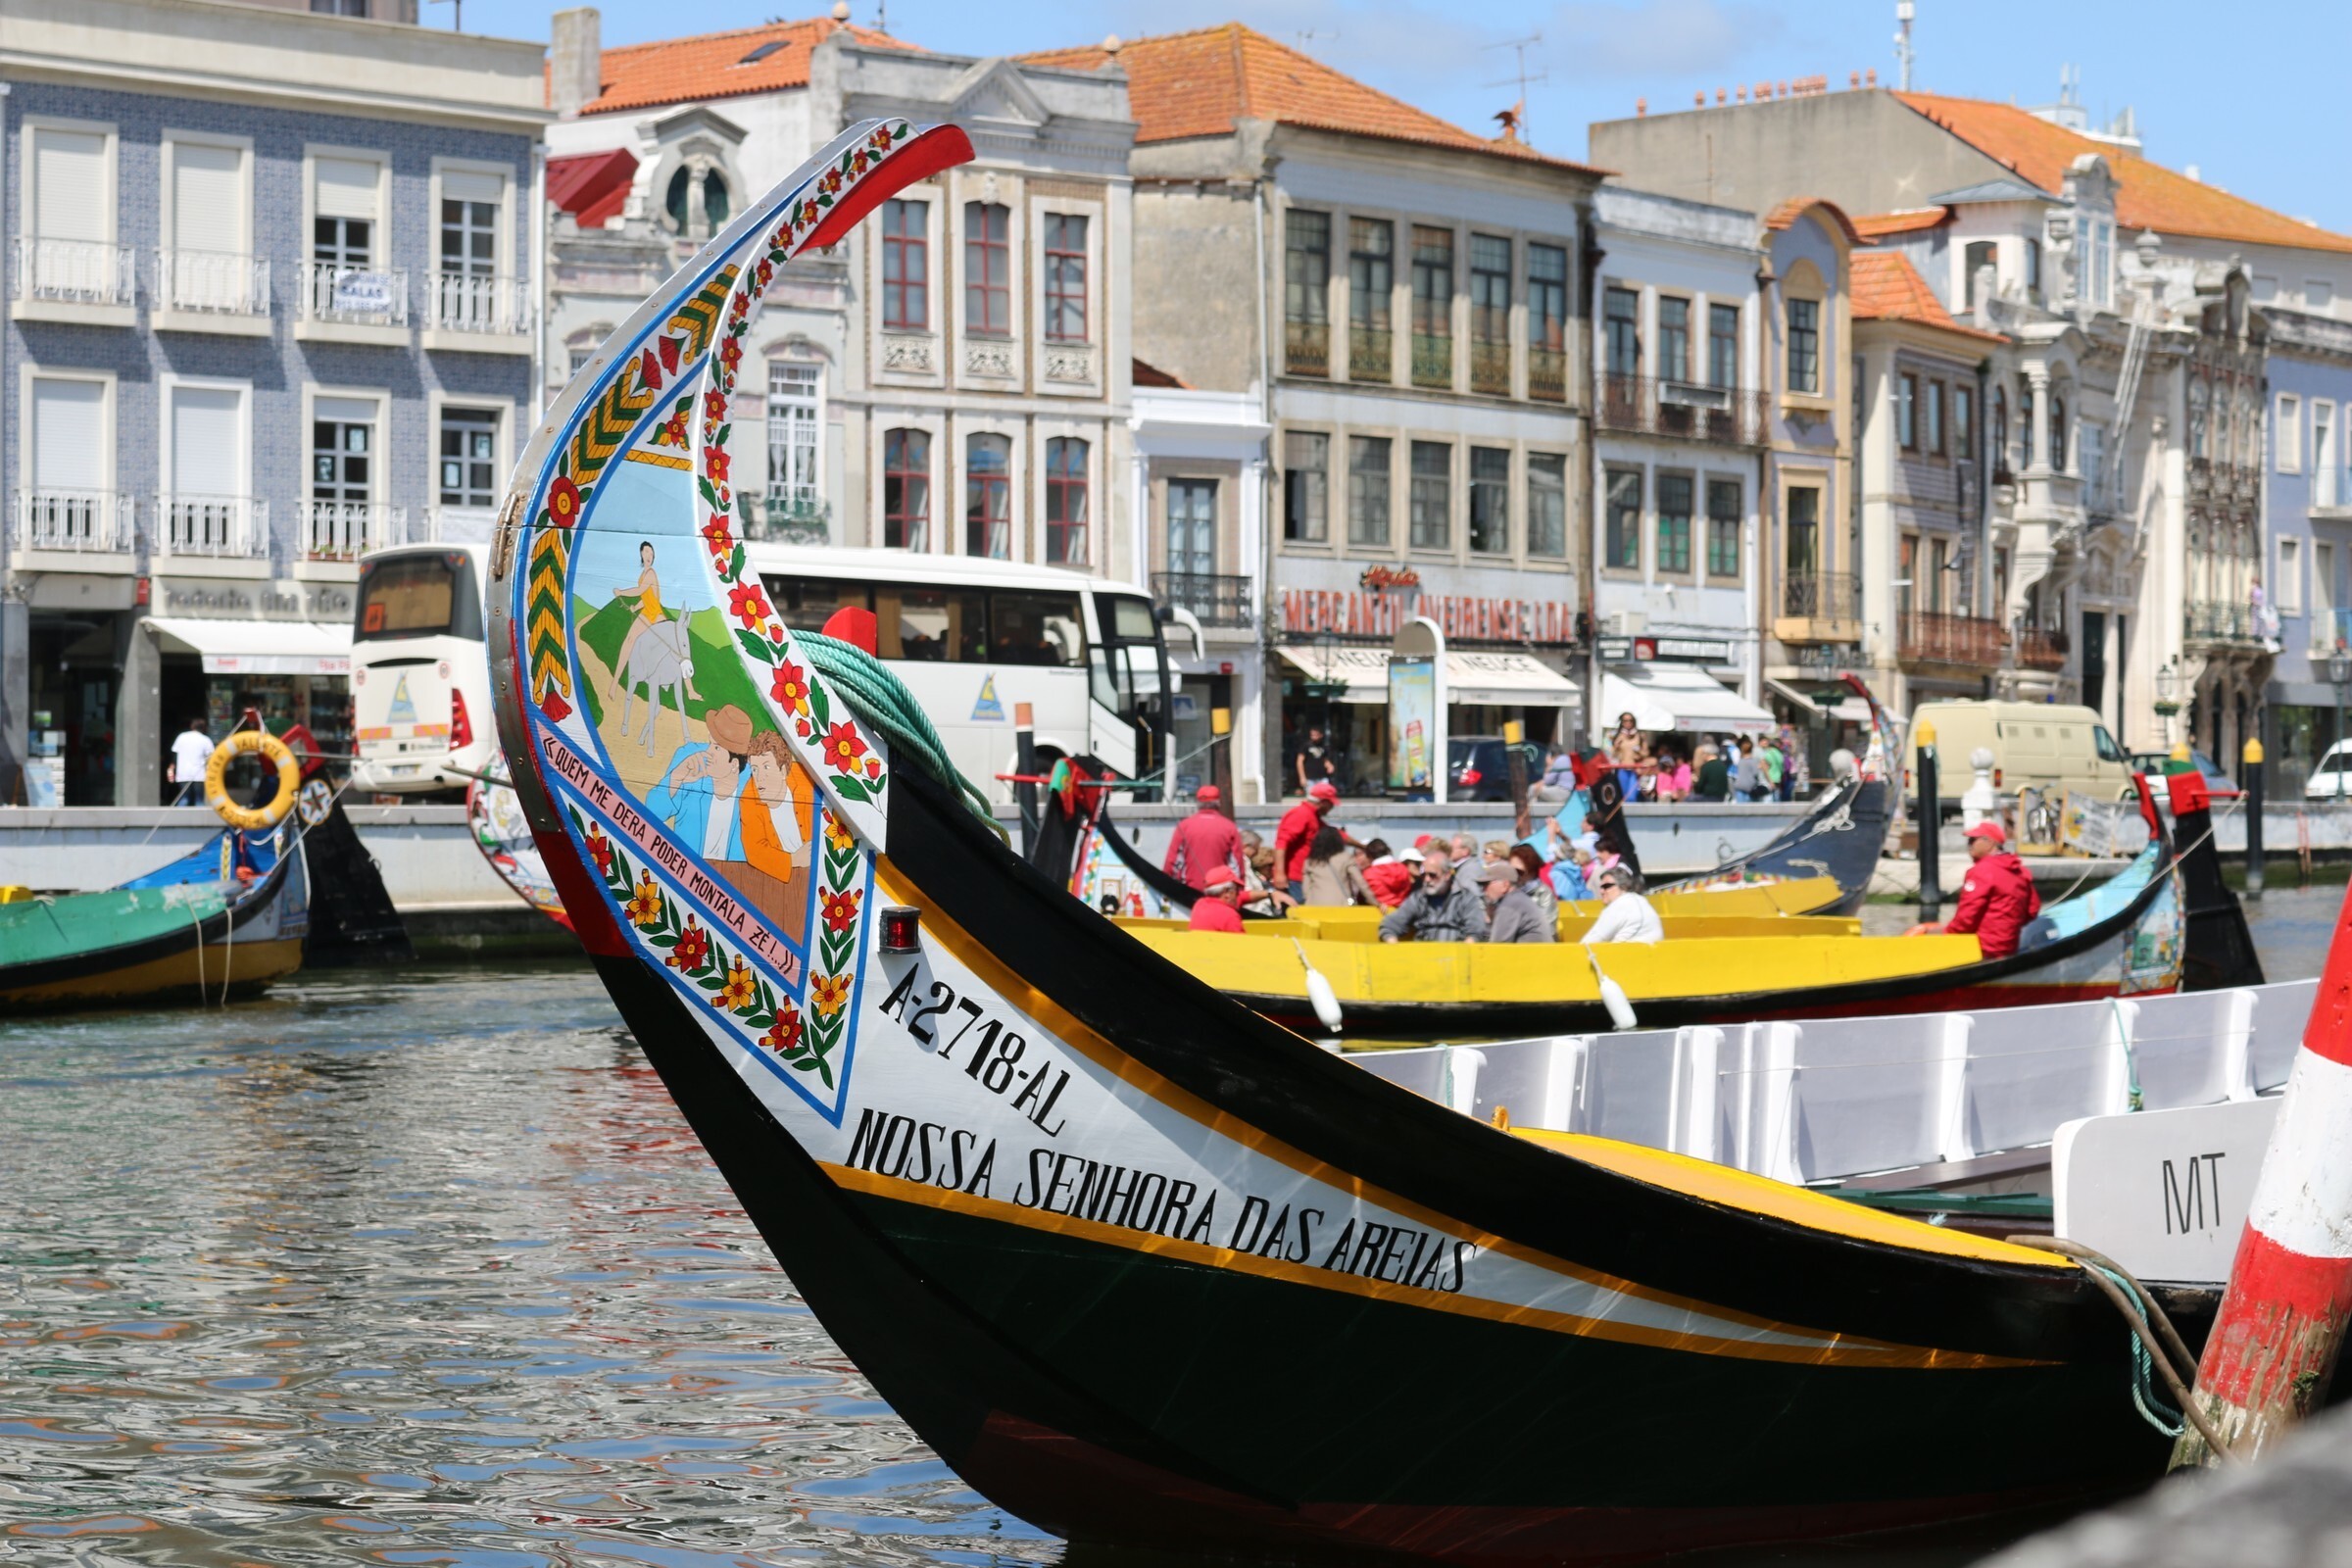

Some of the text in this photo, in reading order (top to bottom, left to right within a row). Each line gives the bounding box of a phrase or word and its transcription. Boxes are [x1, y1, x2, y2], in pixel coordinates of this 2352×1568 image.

[590, 780, 612, 809] ME
[612, 803, 645, 842] DERA
[650, 835, 687, 879] PODER
[879, 962, 1070, 1137] A-2718-AL
[846, 1108, 1478, 1294] NOSSA SENHORA DAS AREIAS
[2162, 1152, 2226, 1235] MT
